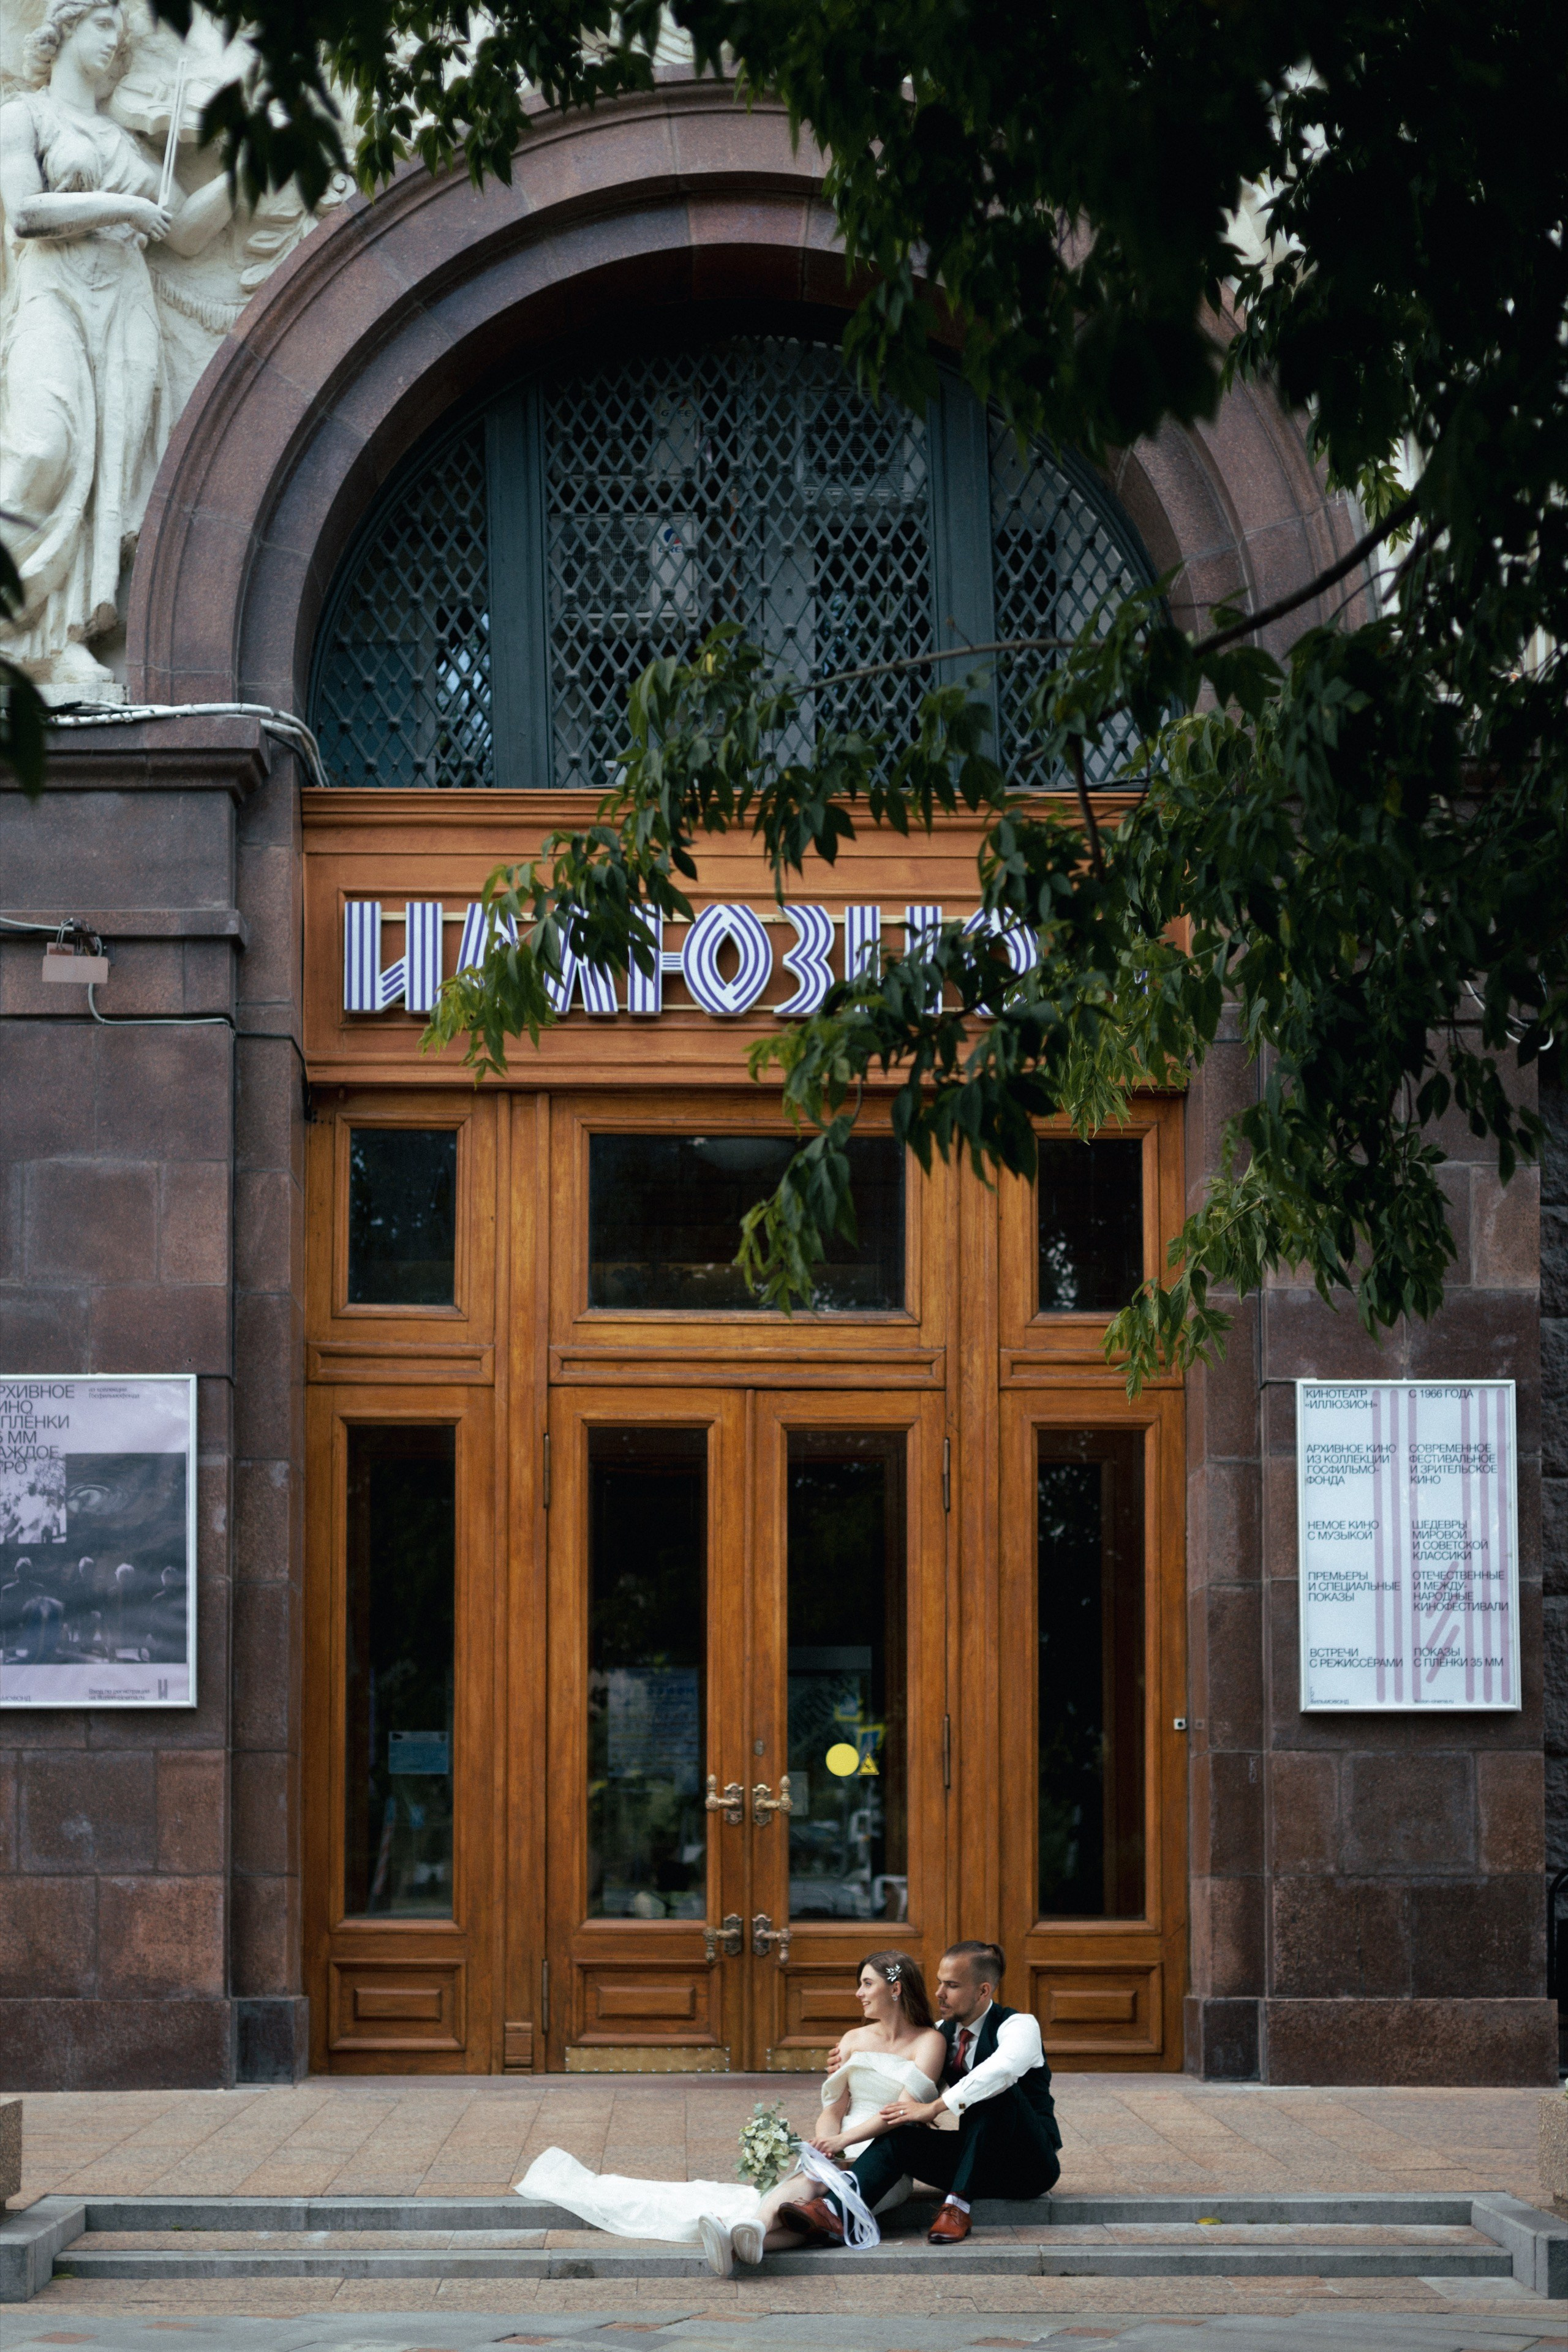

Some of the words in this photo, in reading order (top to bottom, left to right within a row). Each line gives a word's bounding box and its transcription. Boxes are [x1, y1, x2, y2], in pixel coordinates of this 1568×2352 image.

[1306, 1389, 1368, 1398] КИНОТЕАТР
[1408, 1389, 1417, 1398] С
[1420, 1389, 1442, 1398] 1966
[1445, 1389, 1473, 1399] ГОДА
[8, 1430, 37, 1444] ММ
[1306, 1444, 1363, 1453] АРХИВНОЕ
[1366, 1444, 1397, 1453] КИНО
[1409, 1444, 1491, 1453] СОВРЕМЕННОЕ
[1306, 1455, 1322, 1463] ИЗ
[1325, 1455, 1390, 1464] КОЛЛЕКЦИИ
[1409, 1454, 1496, 1463] ФЕСТИВАЛЬНОЕ
[1410, 1465, 1419, 1474] И
[1421, 1464, 1498, 1474] ЗРИТЕЛЬСКОЕ
[1306, 1475, 1346, 1485] ФОНДА
[1410, 1475, 1441, 1484] КИНО
[1308, 1521, 1346, 1530] НЕМОЕ
[1348, 1521, 1379, 1530] КИНО
[1412, 1521, 1468, 1530] ШЕДЕВРЫ
[1307, 1531, 1316, 1540] С
[1318, 1529, 1373, 1540] МУЗЫКОЙ
[1412, 1530, 1468, 1539] МИРОВОЙ
[1412, 1541, 1421, 1550] И
[1423, 1539, 1488, 1550] СОВЕТСКОЙ
[1413, 1551, 1472, 1561] КЛАССИКИ
[1308, 1572, 1369, 1581] ПРЕМЬЕРЫ
[1412, 1571, 1505, 1580] ОТЕЧЕСТВЕННЫЕ
[1308, 1582, 1316, 1591] И
[1318, 1582, 1401, 1592] СПЕЦИАЛЬНЫЕ
[1413, 1581, 1422, 1591] И
[1308, 1593, 1355, 1602] ПОКАЗЫ
[1413, 1592, 1474, 1601] НАРОДНЫЕ
[1413, 1602, 1509, 1611] КИНОФЕСТИВАЛИ
[1310, 1648, 1359, 1657] ВСТРЕЧИ
[1414, 1648, 1461, 1657] ПОКАЗЫ
[1310, 1659, 1317, 1668] С
[1320, 1657, 1403, 1668] РЕЖИССЁРАМИ
[1414, 1658, 1422, 1667] С
[1470, 1658, 1483, 1667] 35
[1485, 1658, 1504, 1667] ММ
